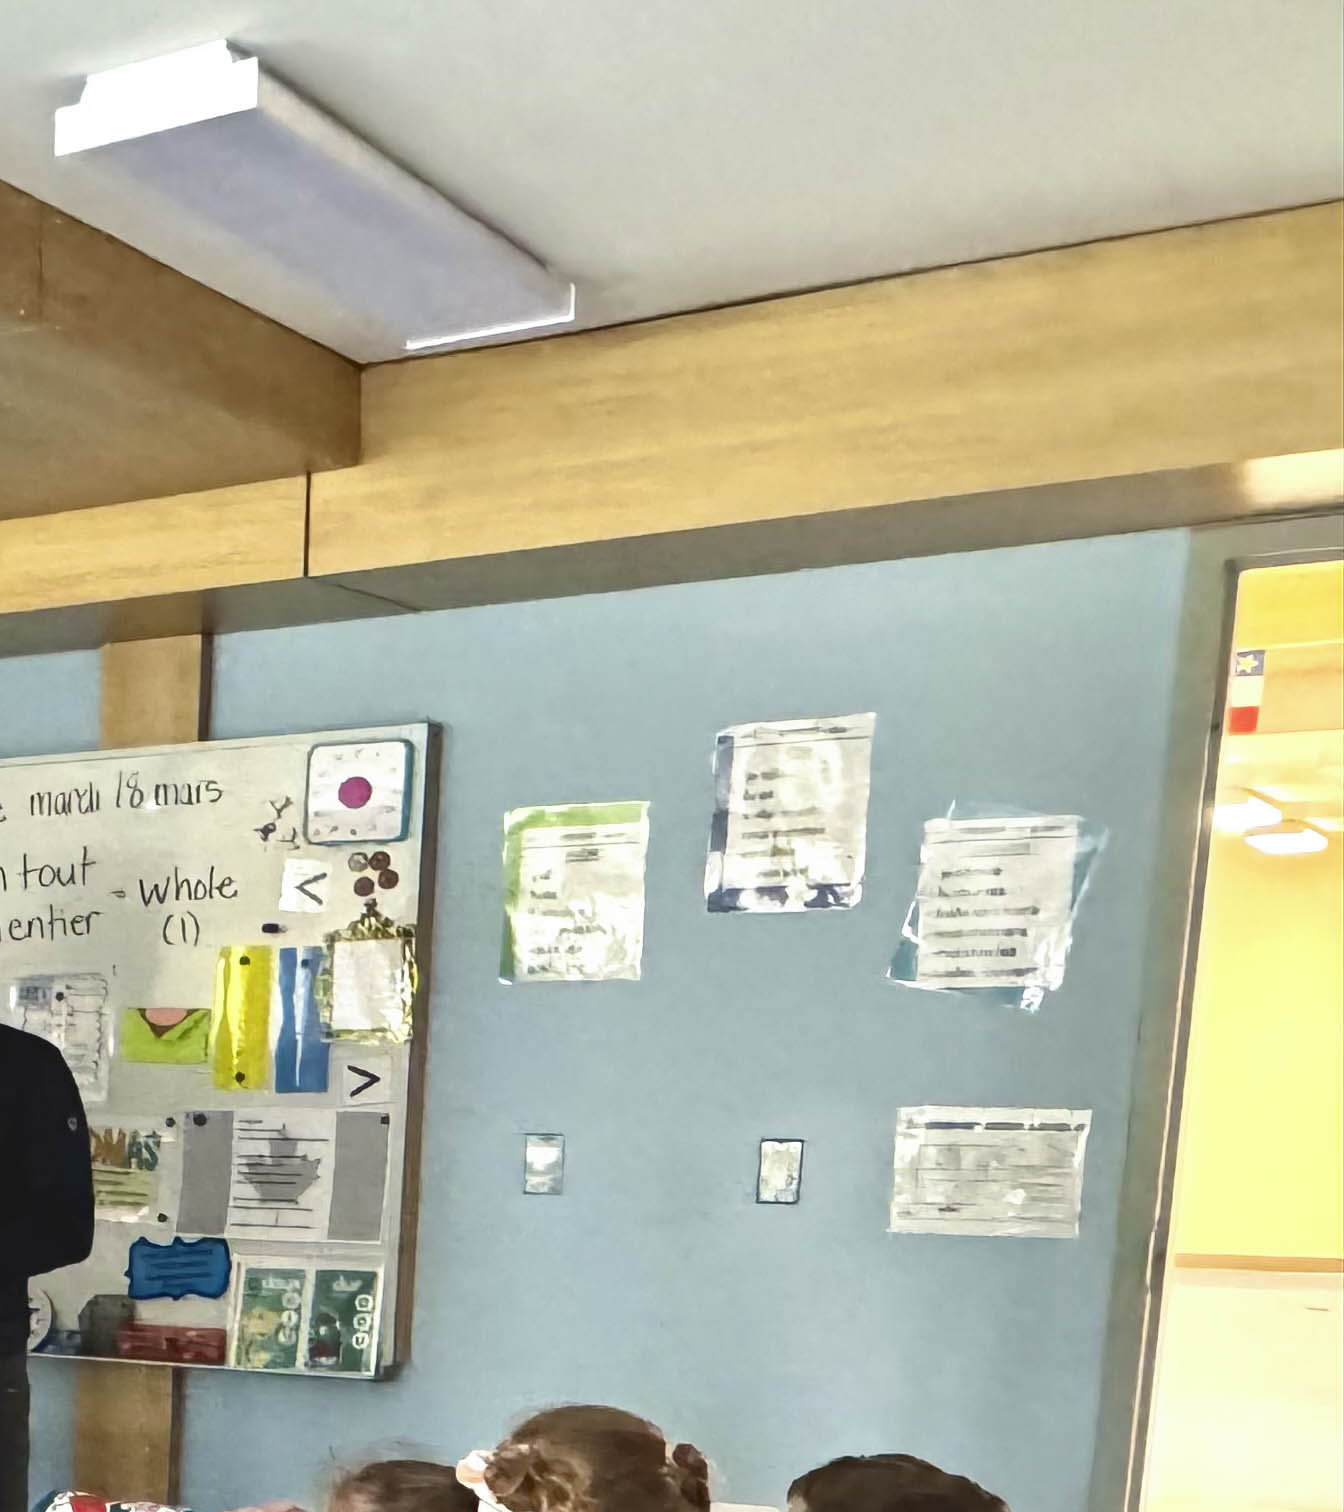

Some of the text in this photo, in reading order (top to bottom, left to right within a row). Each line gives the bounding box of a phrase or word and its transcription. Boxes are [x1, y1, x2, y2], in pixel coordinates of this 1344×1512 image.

[30, 782, 100, 816] mardi
[116, 770, 144, 809] 18
[155, 780, 223, 806] mars
[18, 846, 96, 890] tout
[139, 865, 238, 907] whole
